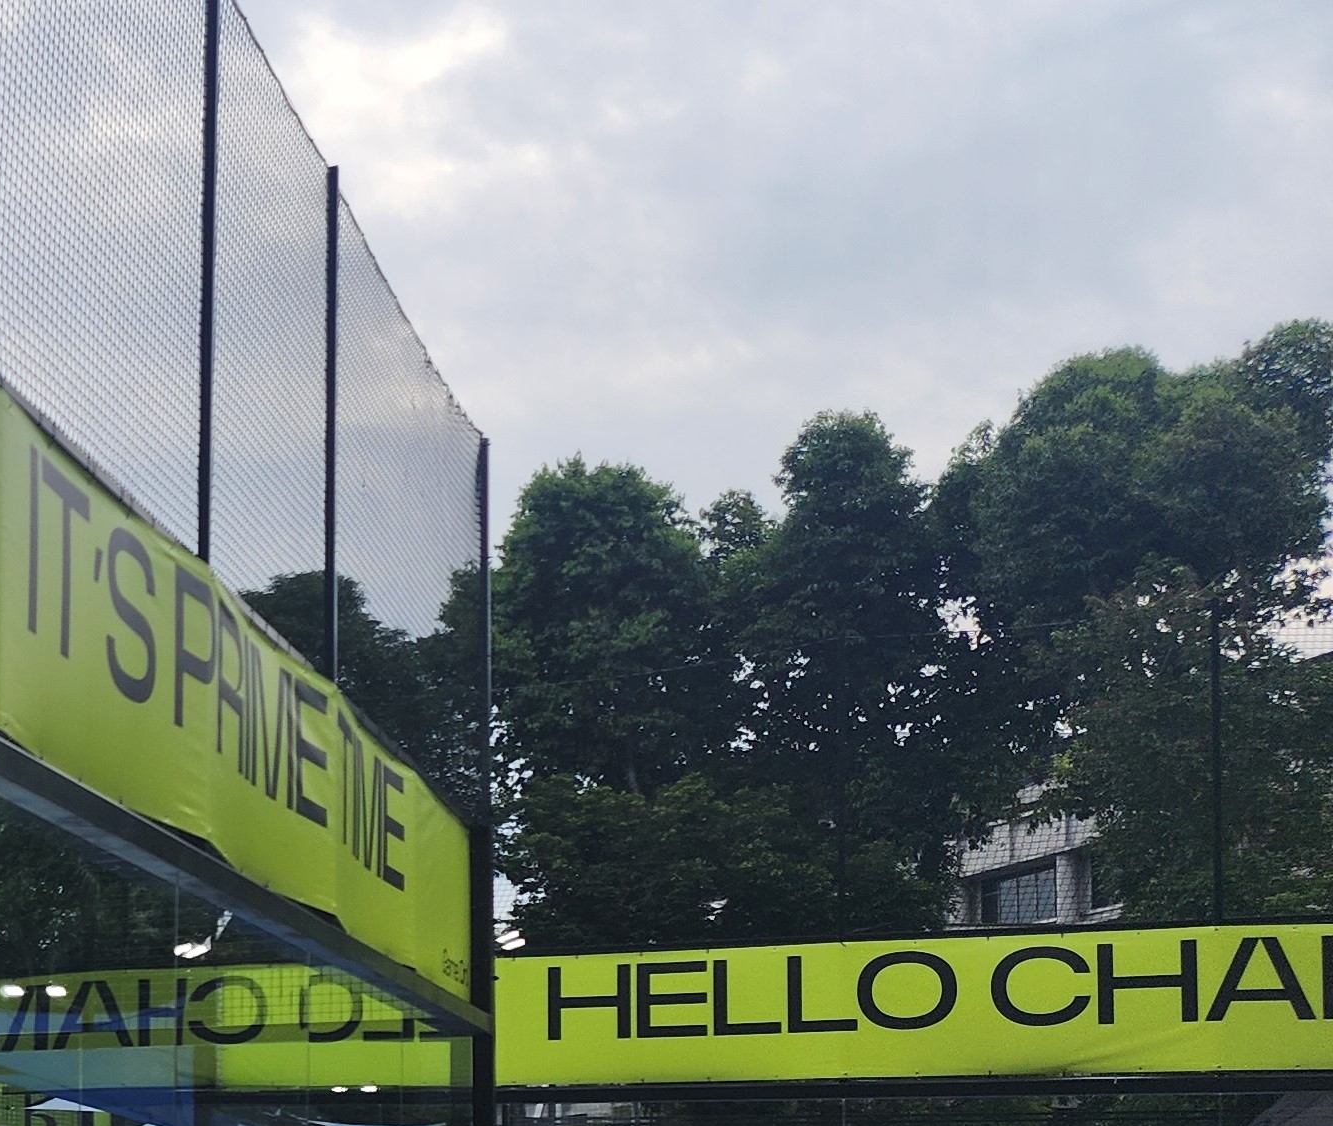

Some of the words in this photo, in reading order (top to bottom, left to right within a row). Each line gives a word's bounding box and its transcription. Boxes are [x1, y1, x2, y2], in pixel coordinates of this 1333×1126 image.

[28, 444, 156, 704] IT'S
[174, 562, 328, 828] PRIME
[338, 707, 405, 891] TIME
[547, 950, 957, 1041] HELLO
[990, 936, 1333, 1027] CHA
